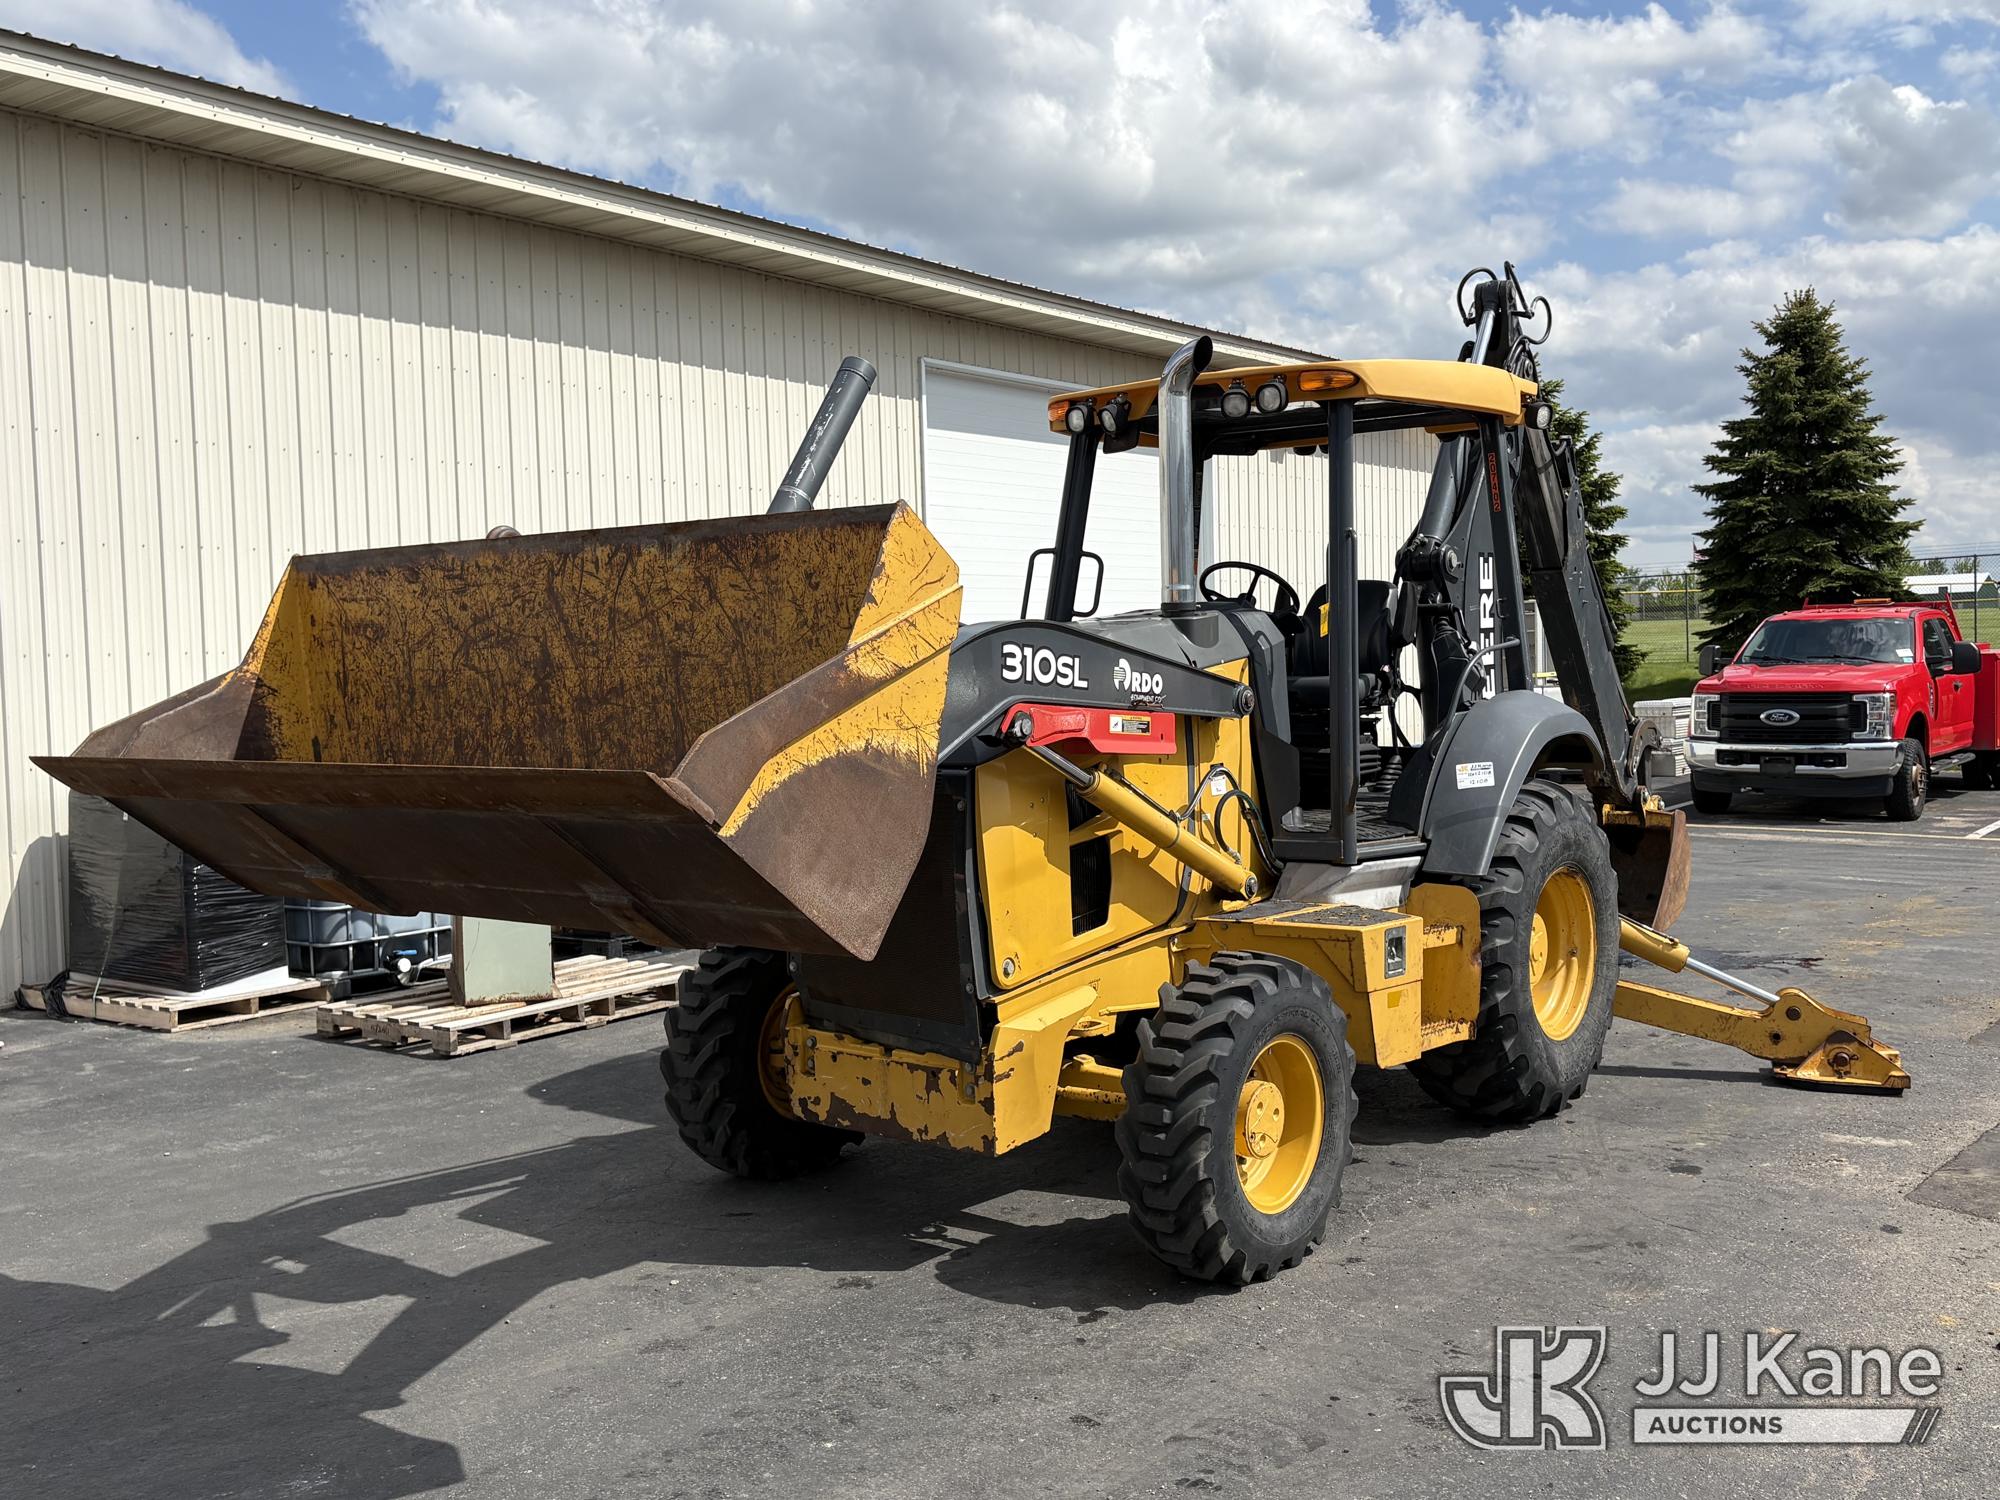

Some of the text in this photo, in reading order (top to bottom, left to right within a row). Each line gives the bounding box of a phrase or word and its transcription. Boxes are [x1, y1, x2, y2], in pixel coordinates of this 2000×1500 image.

[1488, 452, 1501, 513] 207402
[1479, 555, 1496, 700] EERE
[1001, 644, 1089, 689] 310SL
